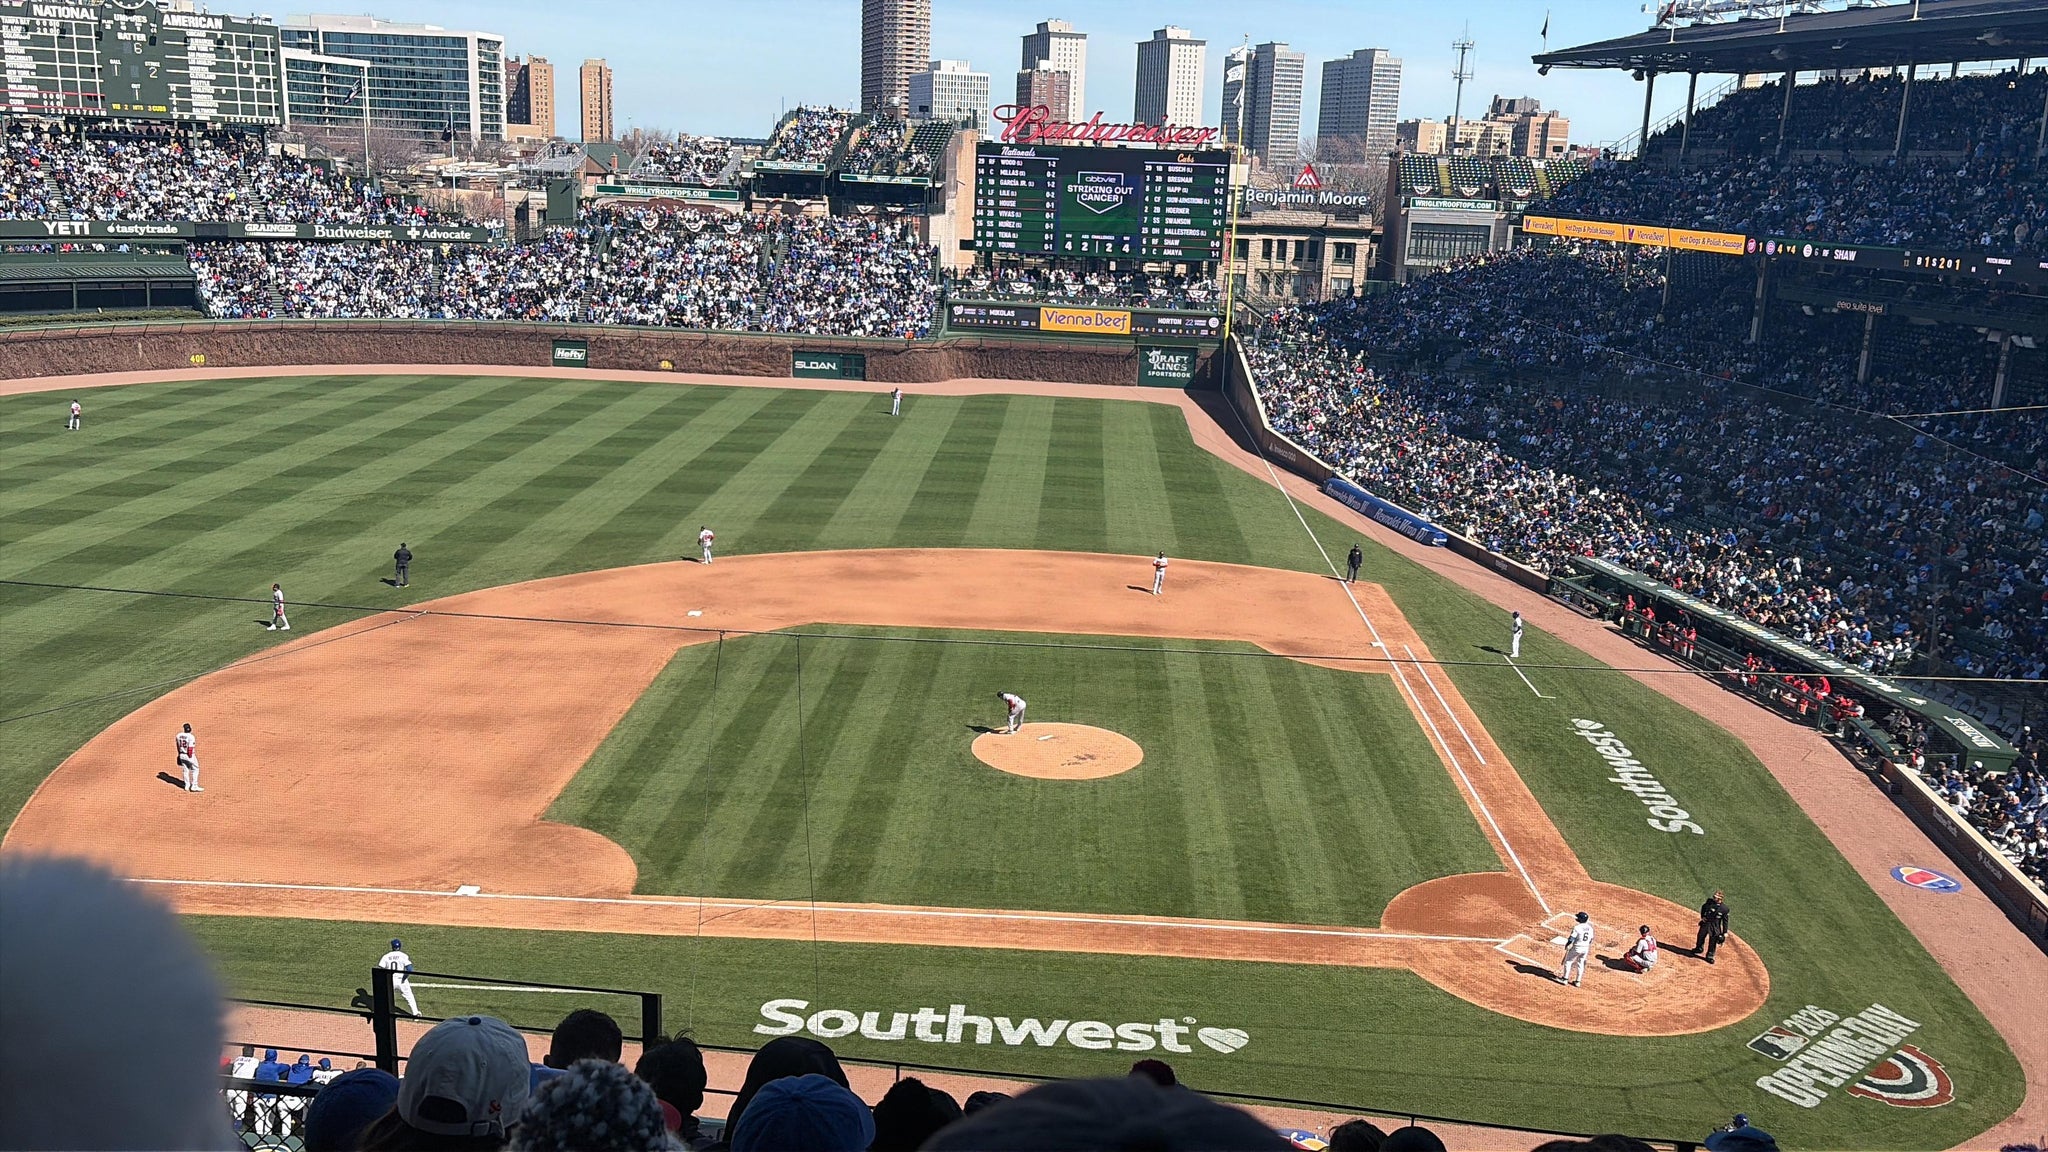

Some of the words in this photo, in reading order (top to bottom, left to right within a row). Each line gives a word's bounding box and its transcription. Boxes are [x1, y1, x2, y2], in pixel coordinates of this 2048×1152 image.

[33, 4, 98, 20] NATIONAL
[163, 14, 222, 29] AMERICAN
[117, 32, 146, 41] BATTER
[134, 43, 142, 54] 6
[149, 67, 157, 78] 2
[993, 105, 1218, 144] Budweiser
[1001, 146, 1036, 156] Nationals
[1178, 153, 1194, 162] Cubs
[625, 187, 709, 197] WRIGLEYROOFTOPS.COM
[1068, 185, 1112, 193] STRIKING
[1081, 194, 1119, 202] CANCER
[1245, 189, 1313, 206] Benjamin
[1320, 191, 1366, 206] Moore
[1415, 199, 1491, 209] WRIGLEYROOFTOPS.COM
[43, 221, 90, 235] YETI
[116, 224, 178, 236] tastytrade
[245, 224, 297, 232] GRAINGER
[1164, 228, 1199, 236] BALLESTEROS
[422, 230, 471, 240] Advocate
[1065, 241, 1072, 250] 4
[1082, 242, 1088, 251] 2
[1106, 243, 1112, 252] 2
[1122, 244, 1129, 253] 4
[1689, 236, 1700, 246] Dogs
[1707, 238, 1721, 246] Polish
[1722, 240, 1742, 250] Sausage
[1778, 244, 1782, 254] 4
[1791, 245, 1796, 254] 4
[1834, 249, 1856, 261] SHAW
[1917, 257, 1922, 265] B
[1925, 256, 1930, 267] 1
[1932, 258, 1937, 266] S
[1939, 258, 1945, 268] 2
[1955, 259, 1960, 270] 1
[1044, 310, 1092, 327] Vienna
[1095, 312, 1128, 331] Beef
[557, 349, 583, 358] Hefty
[1148, 354, 1188, 364] DRAFT
[1153, 362, 1187, 371] KINGS
[1374, 508, 1400, 528] Reynolds
[1399, 519, 1417, 536] Wrap
[1575, 730, 1704, 834] Southwest
[1583, 933, 1588, 941] 6
[753, 998, 1191, 1053] Southwest
[1783, 1005, 1840, 1037] 2026
[1756, 1028, 1888, 1108] OPENING
[1839, 1003, 1922, 1046] DAY
[235, 1062, 244, 1074] 7
